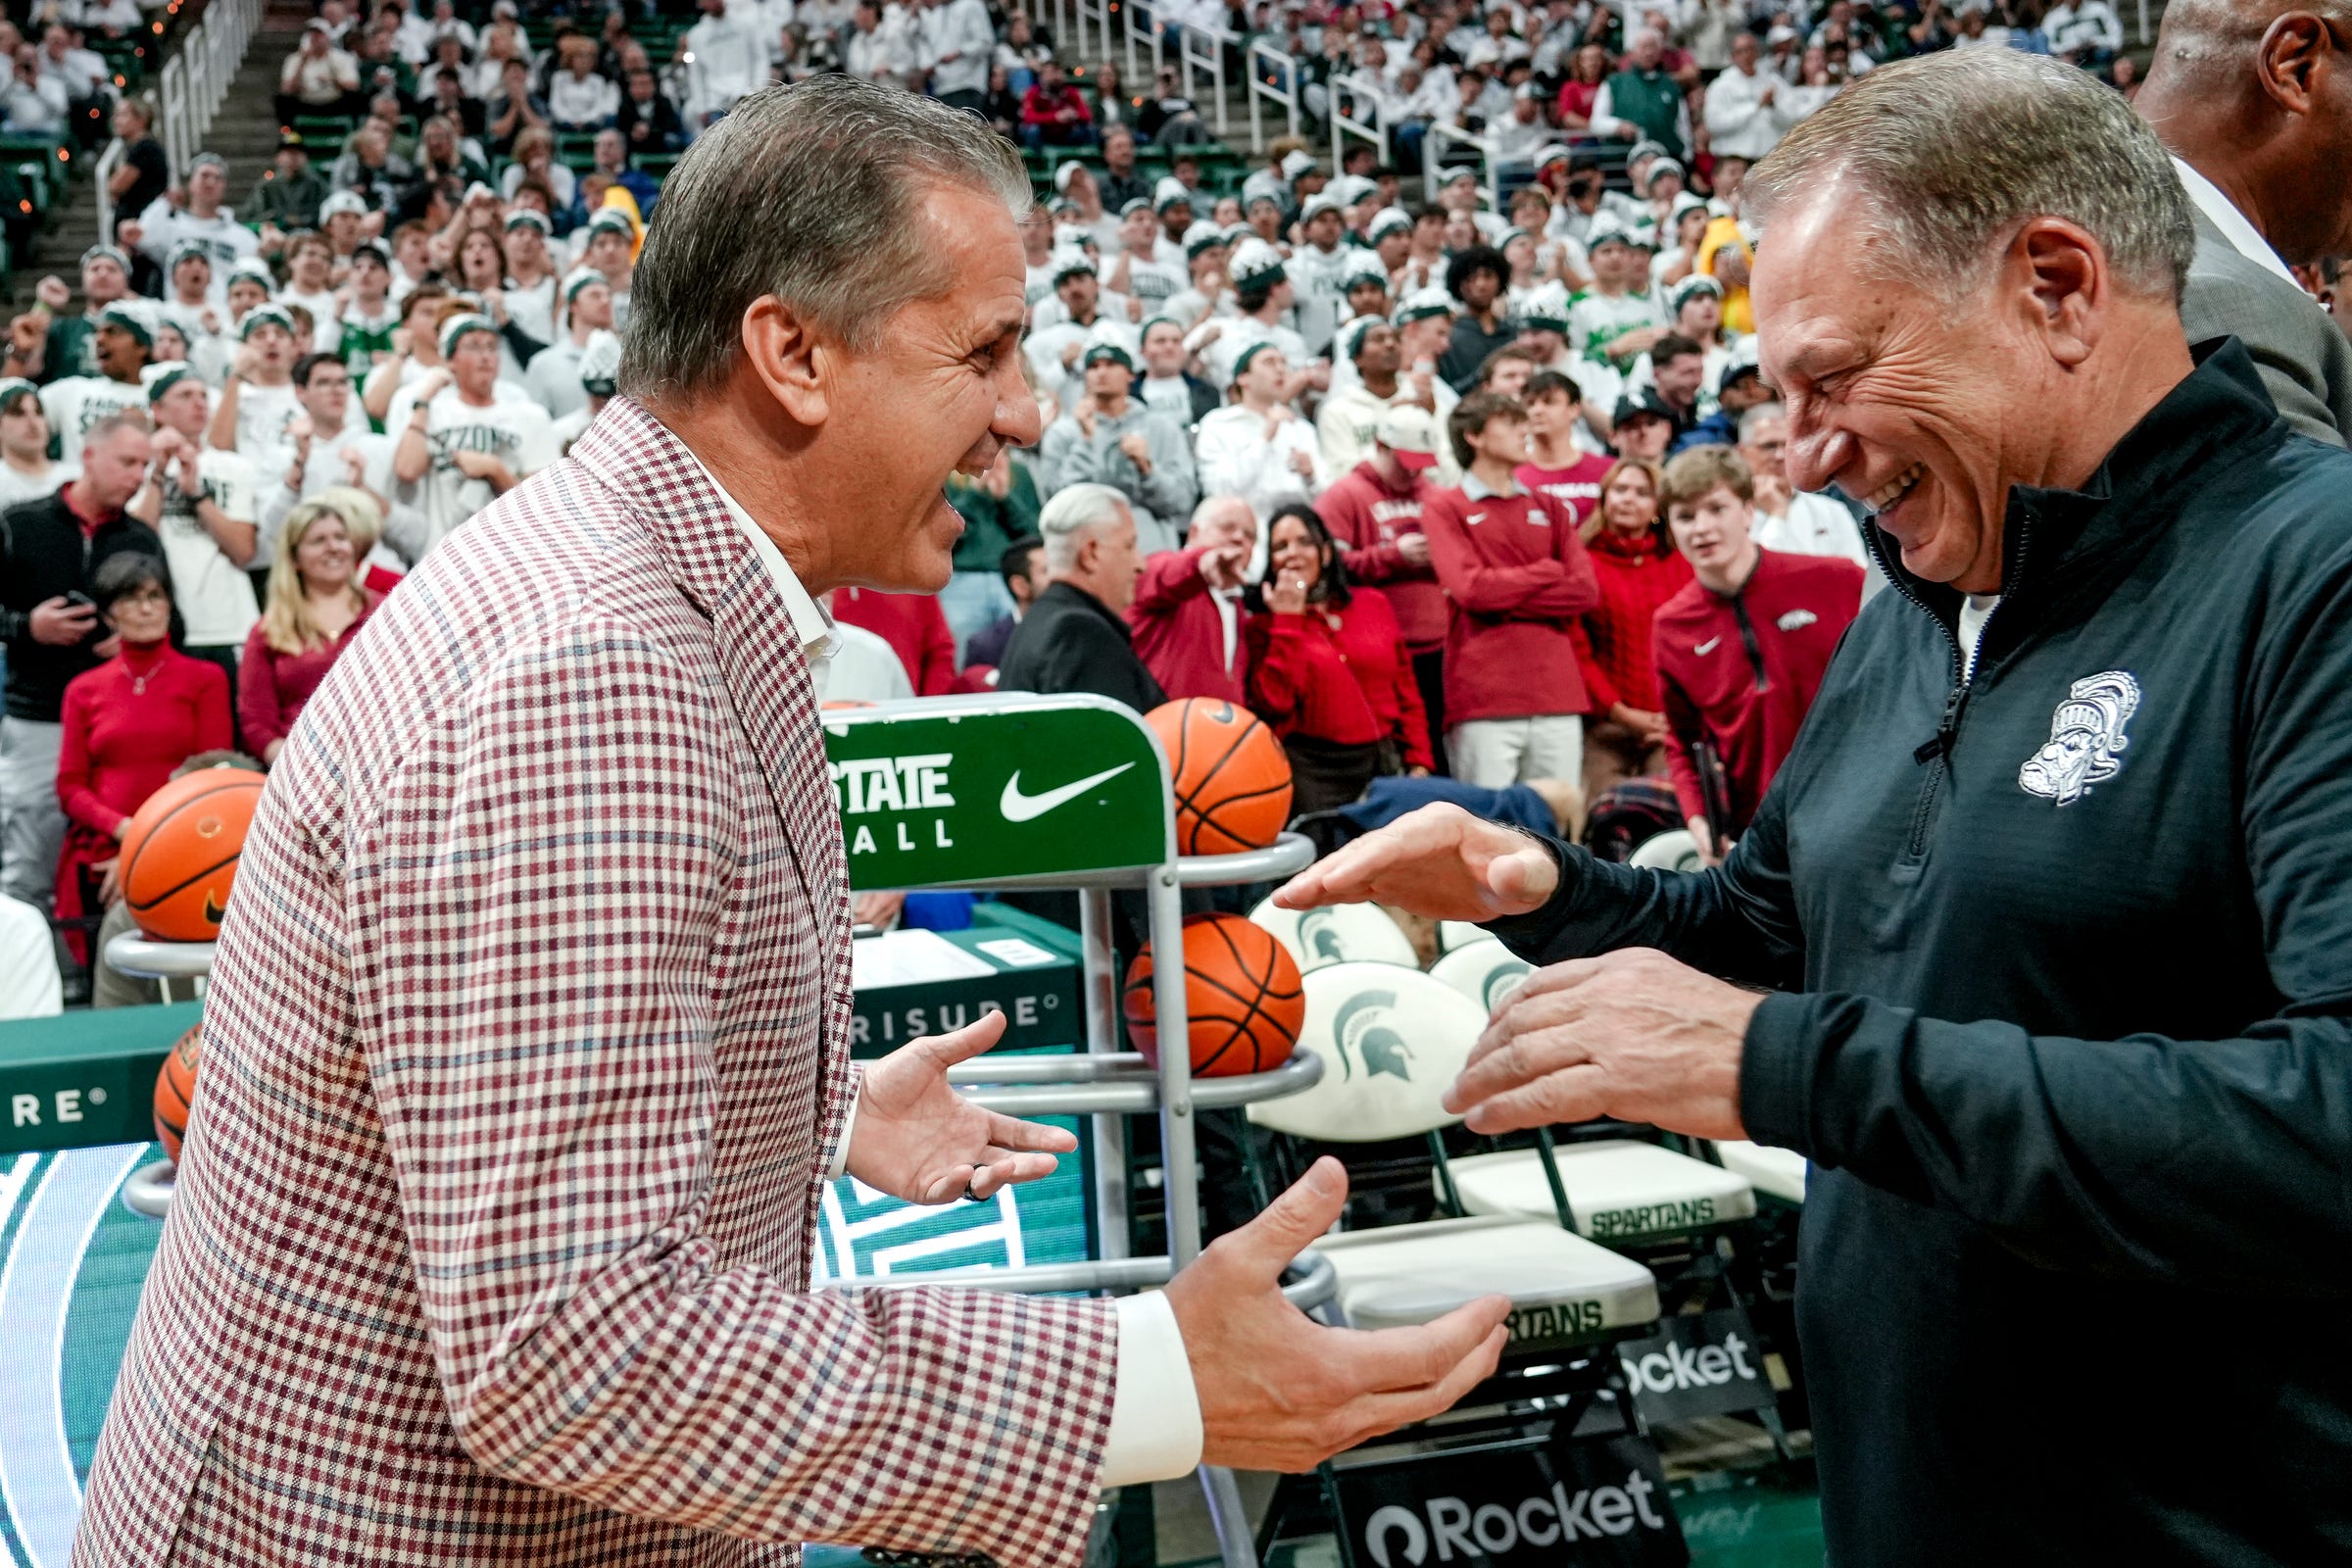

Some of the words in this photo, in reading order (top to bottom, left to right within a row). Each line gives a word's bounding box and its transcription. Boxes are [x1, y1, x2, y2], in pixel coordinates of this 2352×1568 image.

[852, 818, 954, 855] ALL
[1591, 1198, 1715, 1237] SPARTANS
[1426, 1469, 1665, 1562] Rocket
